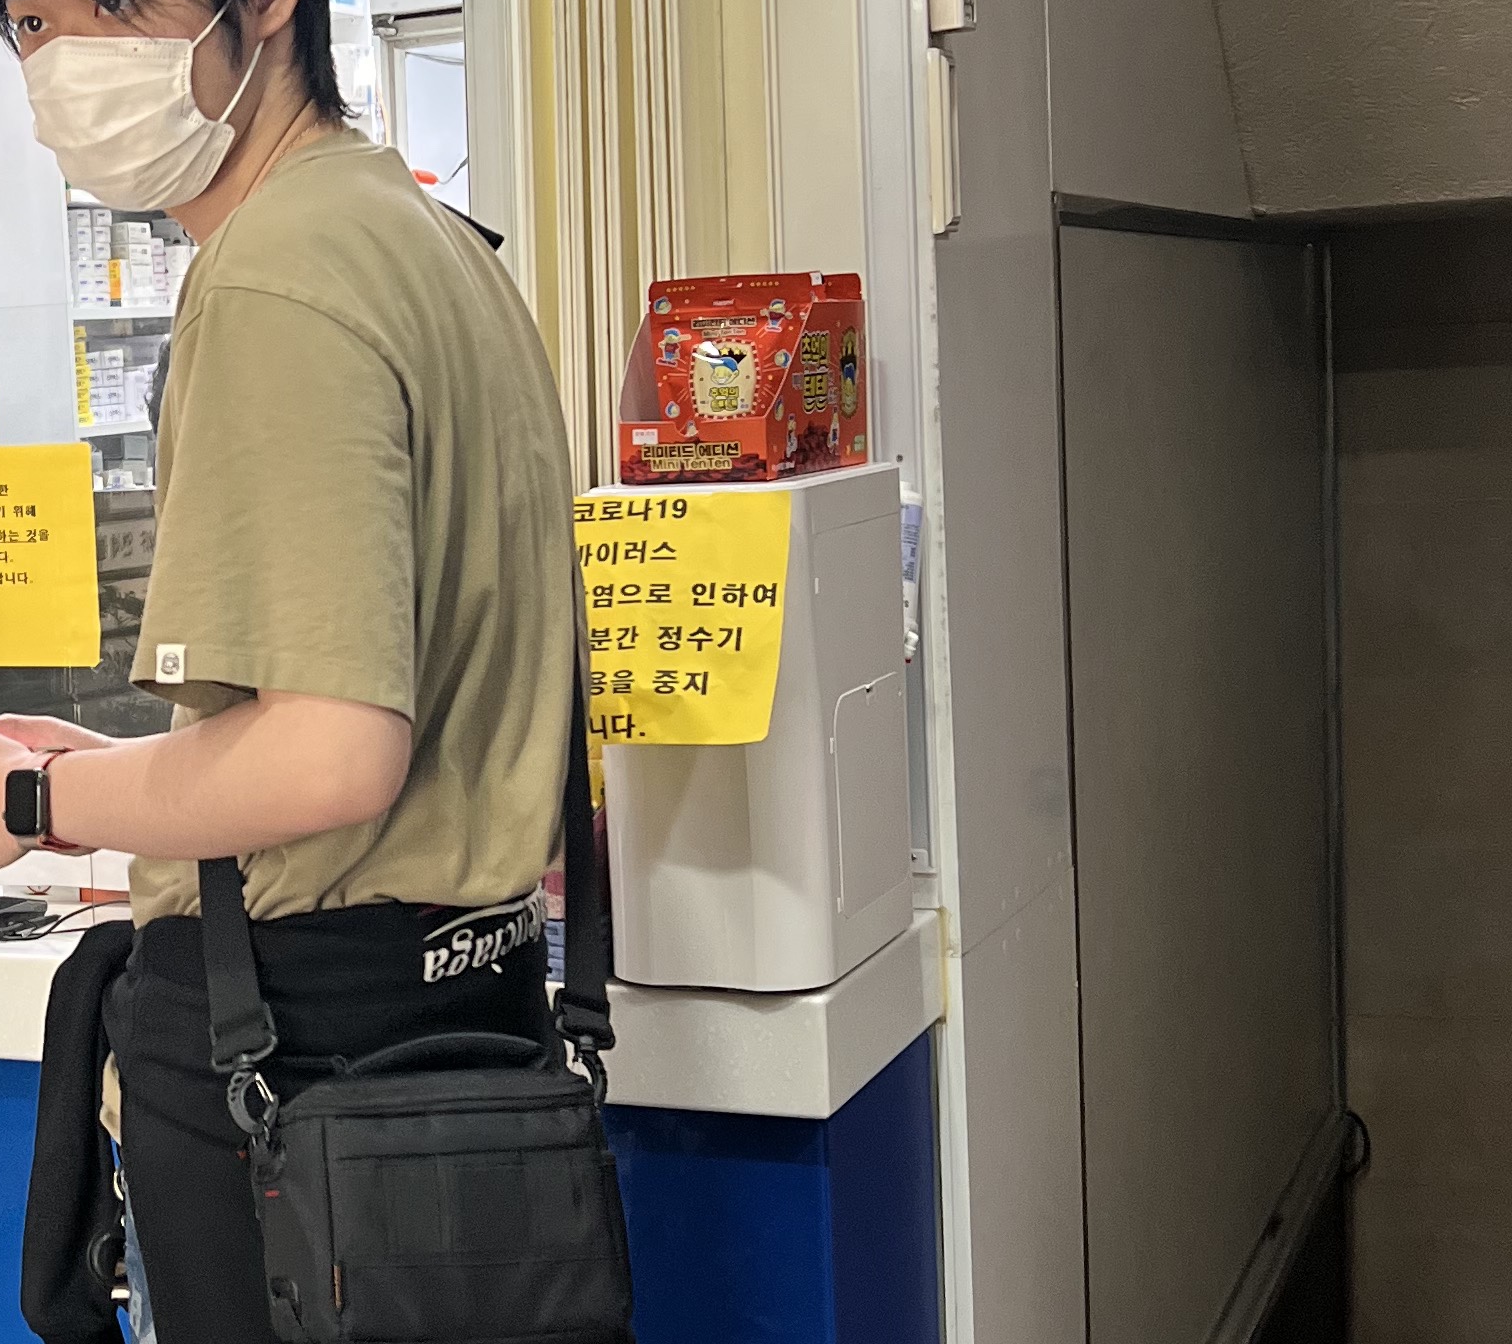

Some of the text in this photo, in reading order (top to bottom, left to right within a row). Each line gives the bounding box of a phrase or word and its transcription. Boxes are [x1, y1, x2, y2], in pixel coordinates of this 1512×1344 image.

[642, 442, 739, 459] 리미티드 에디션
[652, 458, 679, 470] Mini
[13, 505, 36, 518] 위해
[574, 498, 688, 523] 코로나19
[26, 528, 49, 543] 것을
[585, 582, 778, 608] 염으로 인하여
[657, 626, 743, 651] 정수기
[652, 669, 709, 695] 중지
